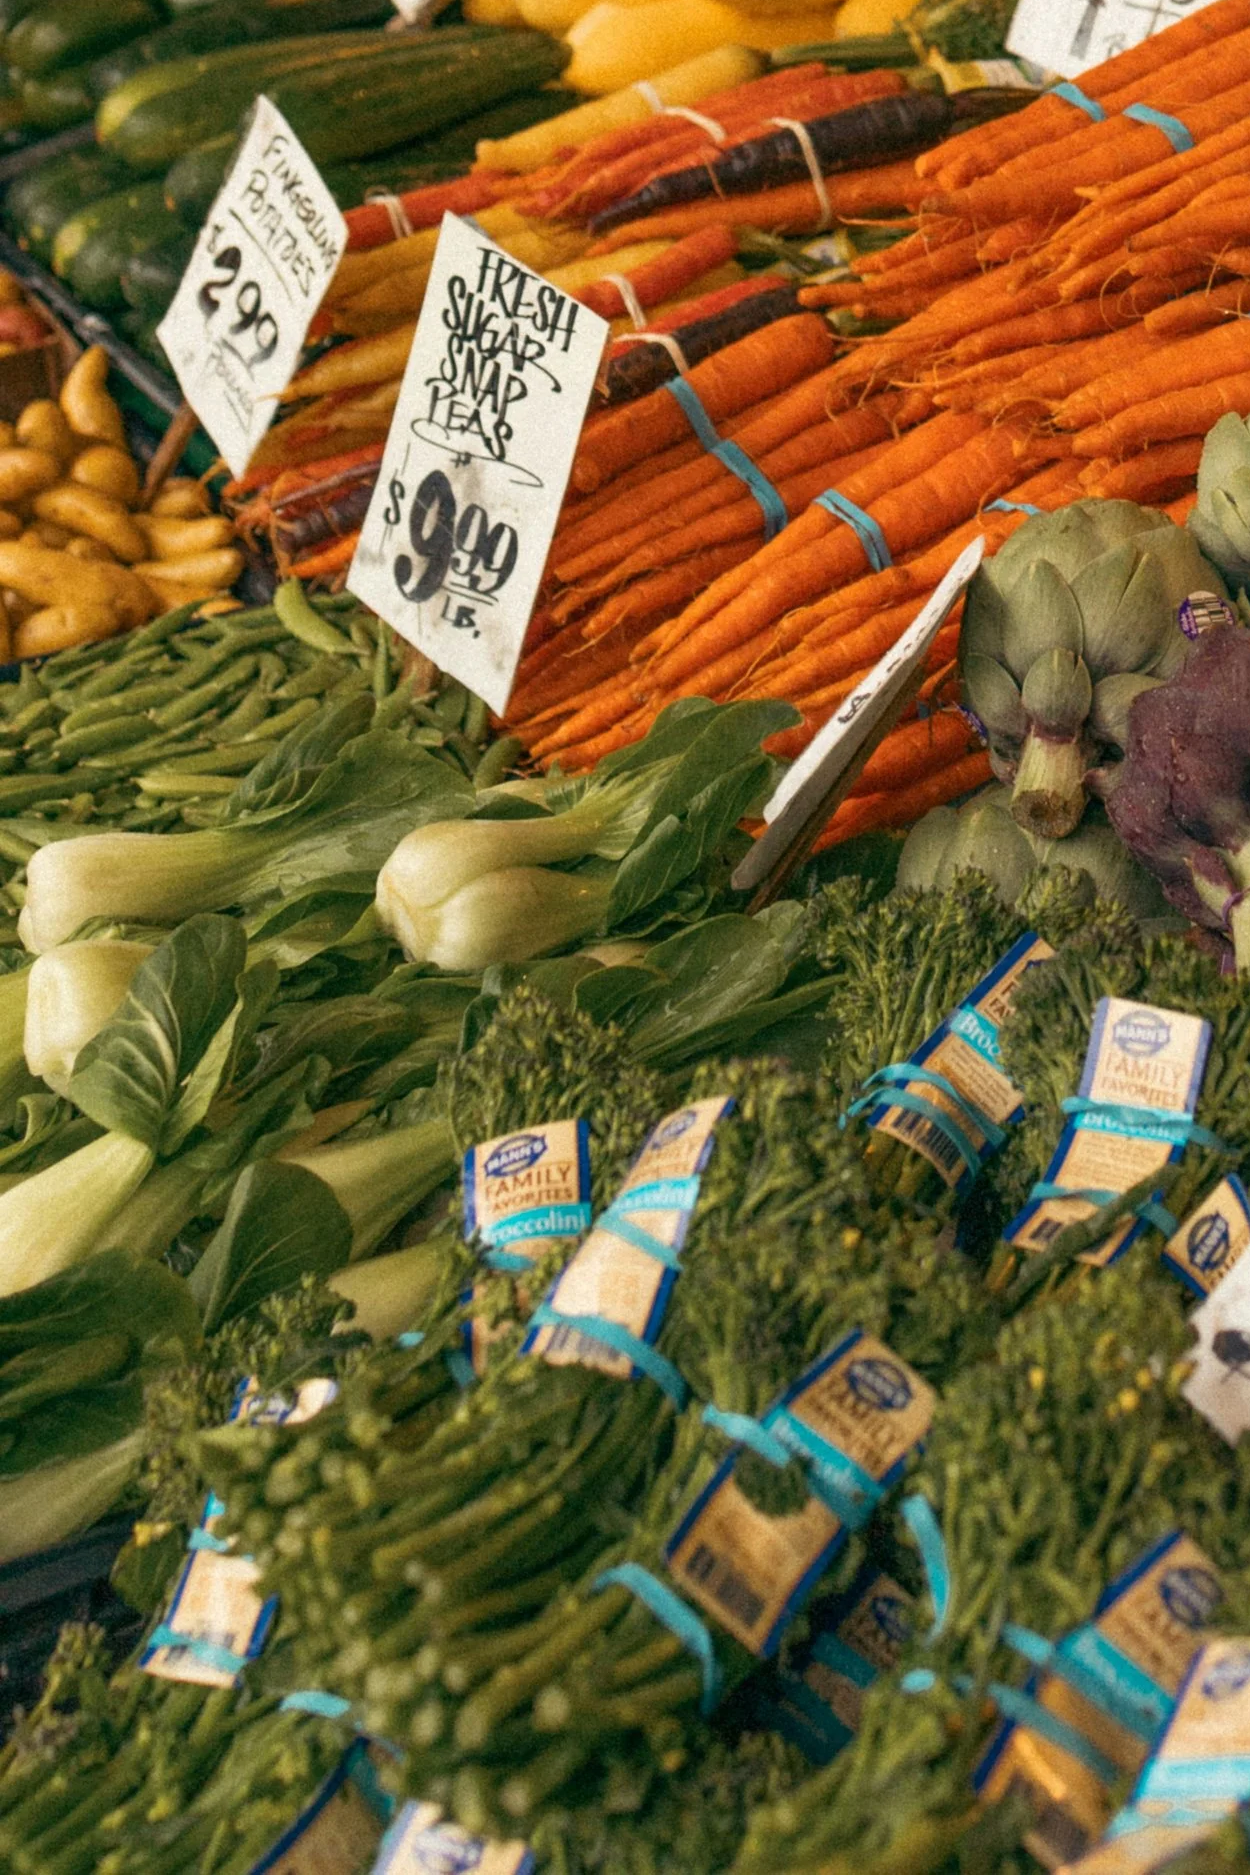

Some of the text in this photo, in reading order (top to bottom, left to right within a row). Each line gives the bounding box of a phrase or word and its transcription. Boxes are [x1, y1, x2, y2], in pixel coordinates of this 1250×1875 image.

[244, 170, 319, 296] POTATOES
[443, 276, 561, 393] SUGAR
[477, 246, 578, 352] FRESH
[425, 377, 512, 461] PEAS
[441, 333, 528, 422] SNAP
[1104, 1048, 1185, 1087] FAMILY
[485, 1165, 571, 1201] FAMILY
[488, 1139, 544, 1171] MANN'S
